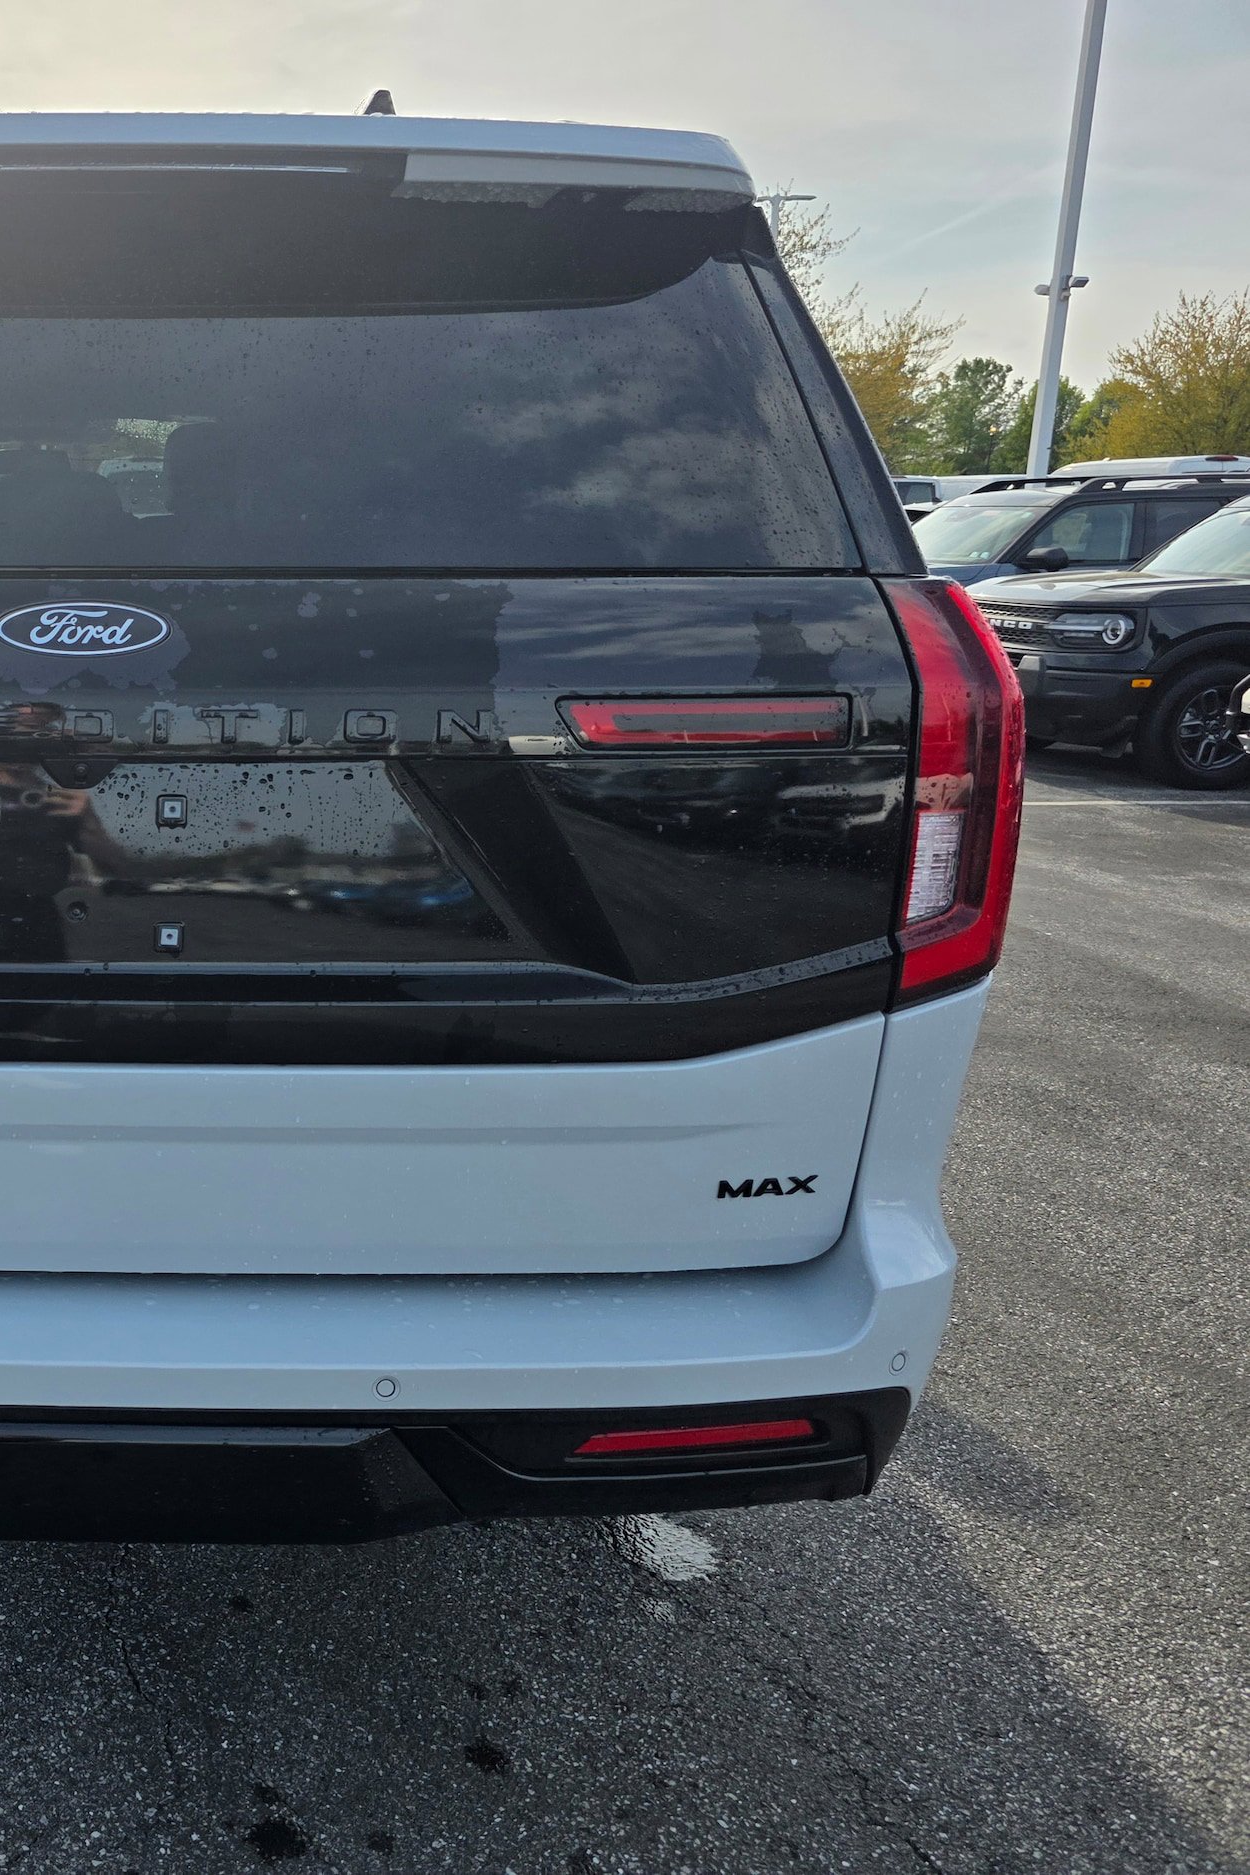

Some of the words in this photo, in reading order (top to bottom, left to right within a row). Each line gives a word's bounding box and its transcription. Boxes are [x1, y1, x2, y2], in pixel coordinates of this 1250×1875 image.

[29, 609, 134, 645] Ford
[990, 619, 1033, 630] NCO
[716, 1174, 819, 1199] MAX
